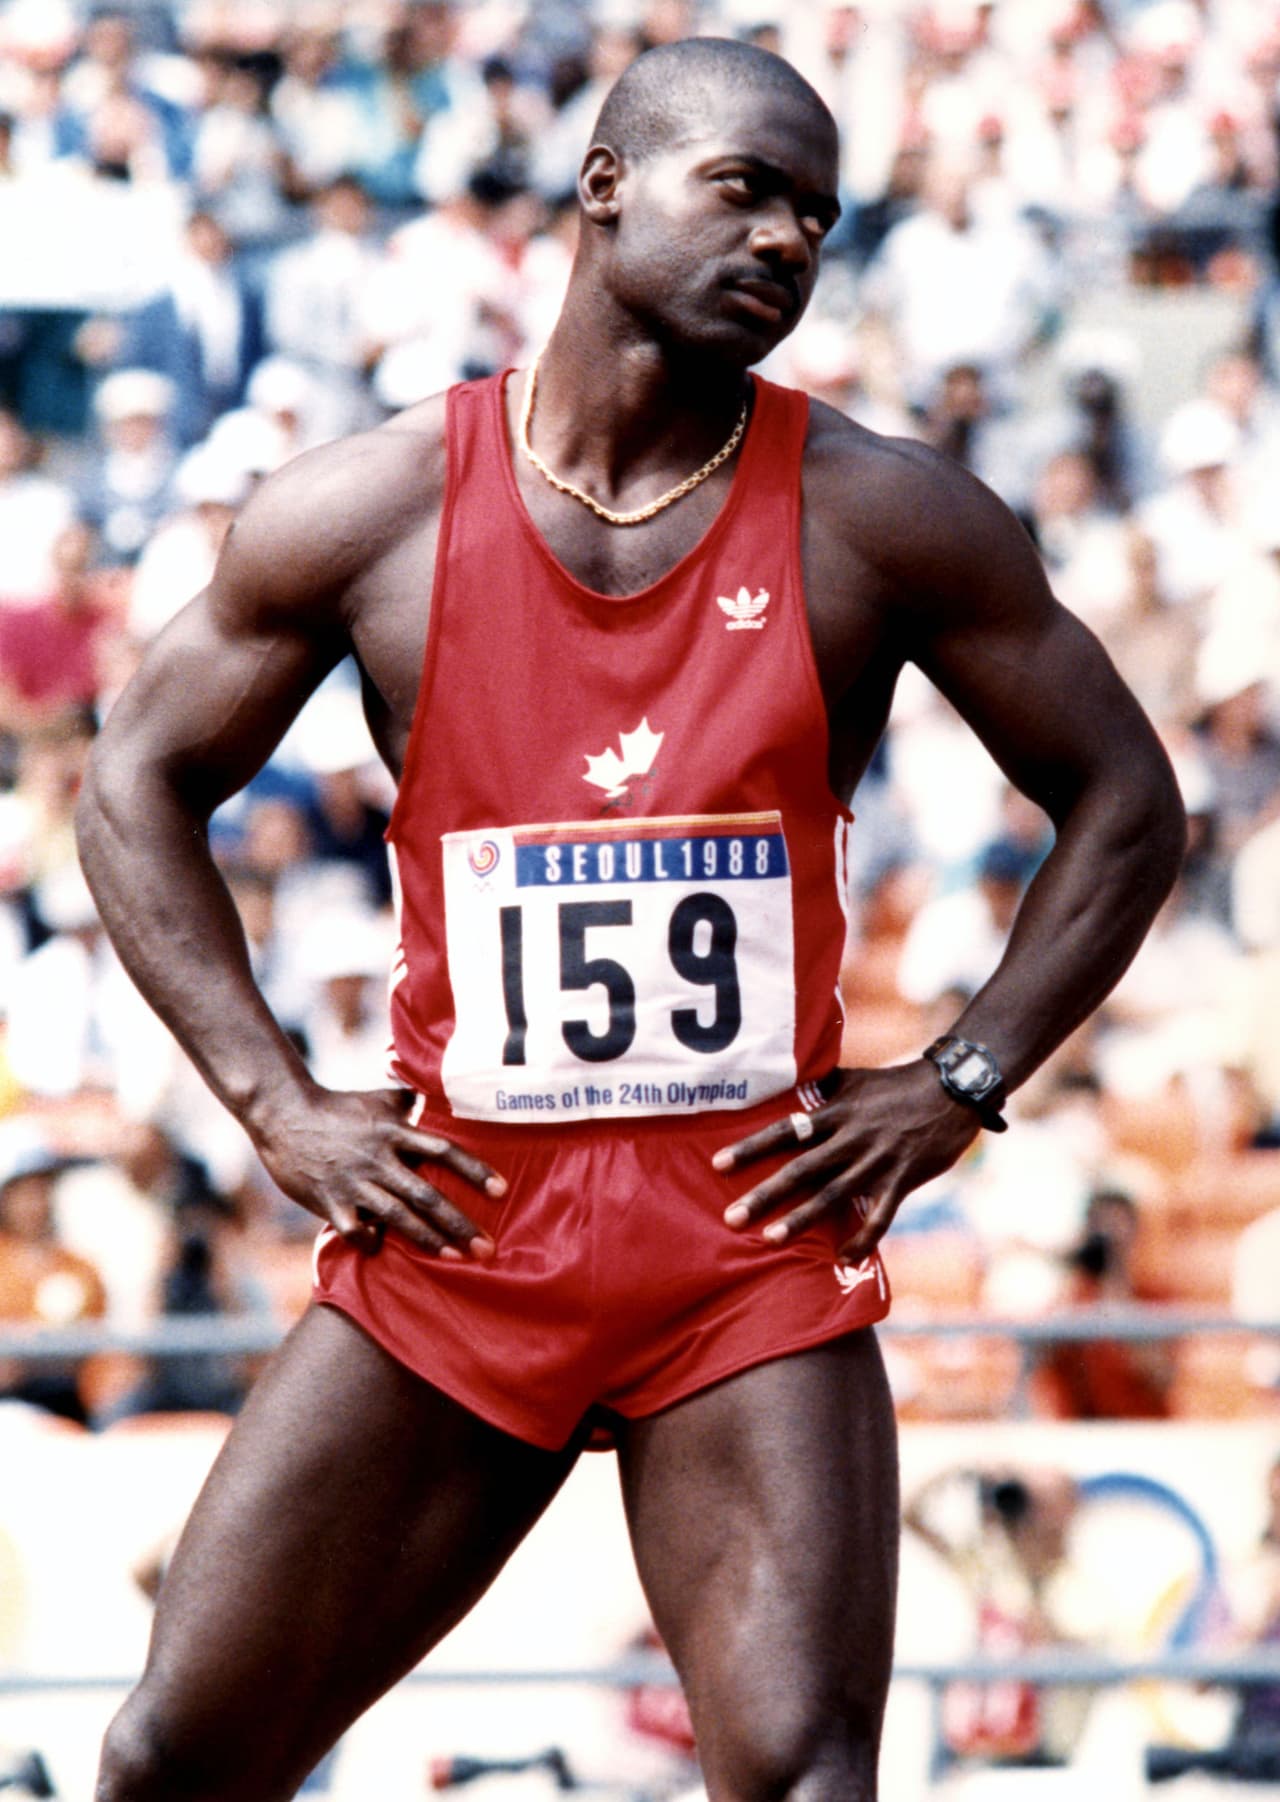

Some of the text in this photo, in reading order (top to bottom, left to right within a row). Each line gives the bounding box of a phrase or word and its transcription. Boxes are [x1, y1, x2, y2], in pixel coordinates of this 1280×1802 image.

[544, 839, 770, 883] SEOUL 1988
[499, 891, 742, 1067] 159
[496, 1079, 748, 1110] Games of the 24th Olympiad
